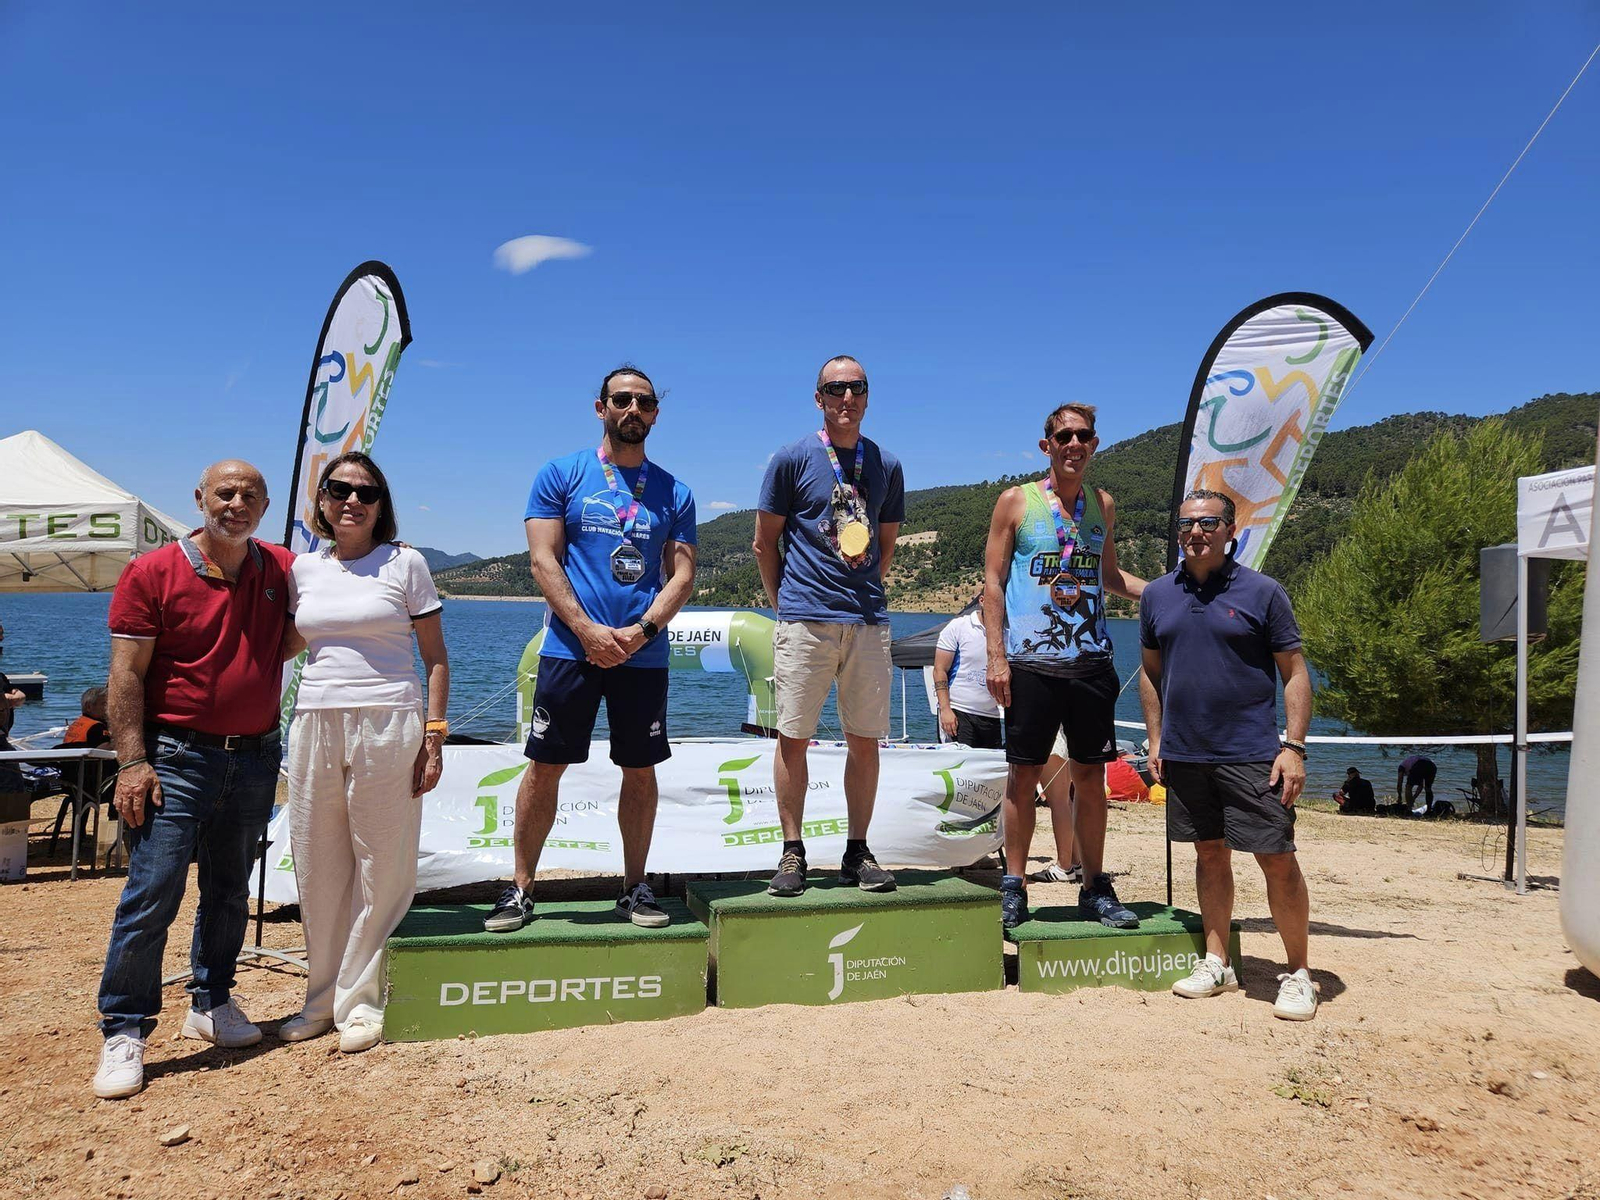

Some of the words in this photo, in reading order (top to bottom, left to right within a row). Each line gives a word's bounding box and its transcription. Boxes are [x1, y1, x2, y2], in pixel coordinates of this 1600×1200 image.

[1289, 371, 1350, 489] DEPORTES
[0, 513, 121, 539] TES
[668, 631, 684, 641] DE
[686, 628, 721, 641] JAÉN
[956, 792, 968, 805] DE
[722, 820, 849, 846] DEPOTES
[467, 838, 611, 852] DEPRTES
[846, 956, 906, 970] DIPUTACIÓN
[1037, 949, 1199, 980] www.dipujaen
[847, 972, 860, 981] DE
[862, 968, 887, 981] JAÉN
[440, 975, 662, 1006] DEPORTES
